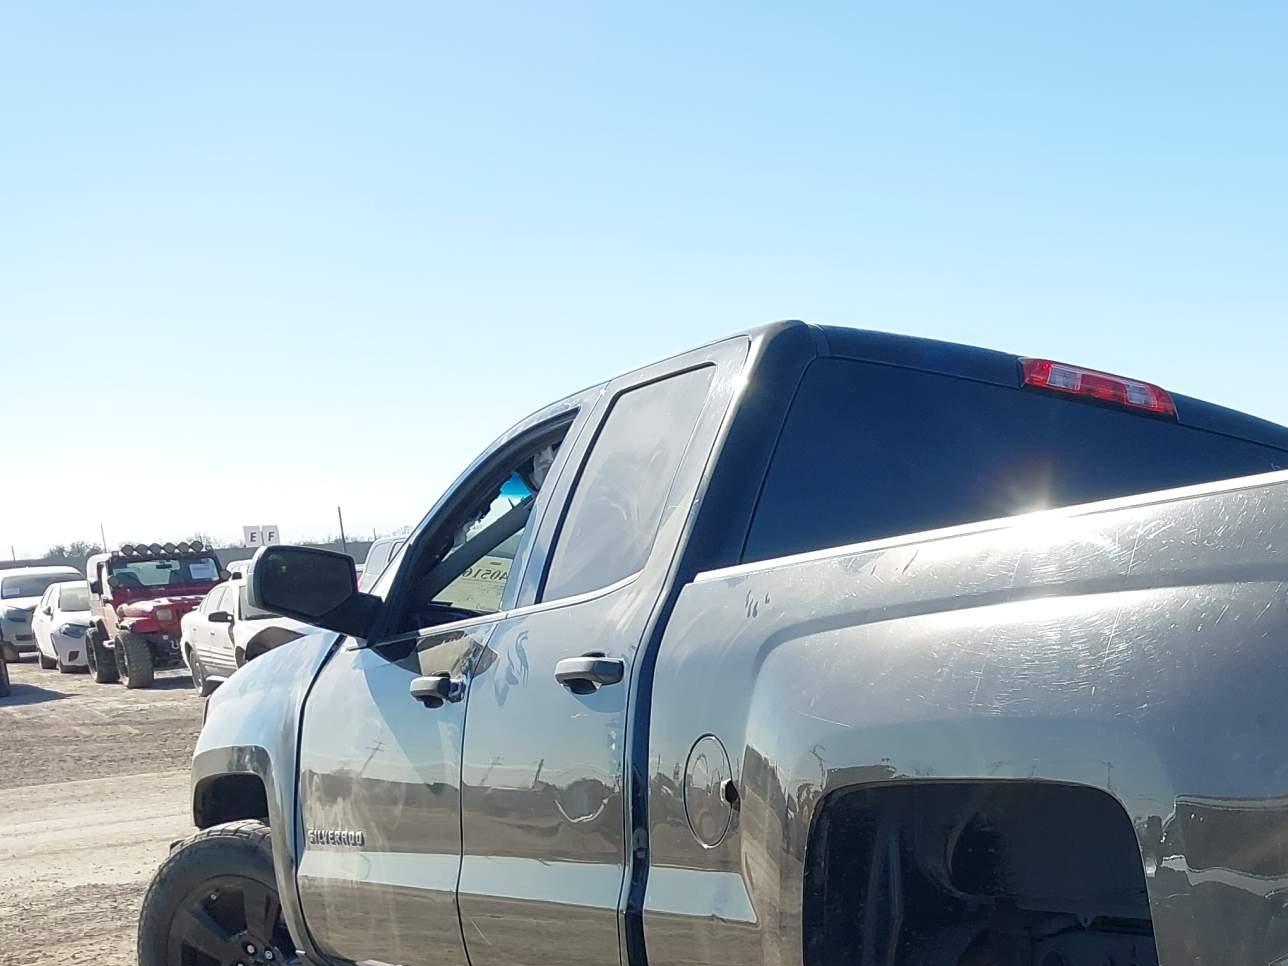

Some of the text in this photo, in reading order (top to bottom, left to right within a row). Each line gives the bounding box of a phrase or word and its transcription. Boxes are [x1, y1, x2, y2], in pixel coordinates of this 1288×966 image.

[250, 531, 257, 542] E
[268, 531, 275, 542] F
[307, 830, 365, 846] SILVERADO
